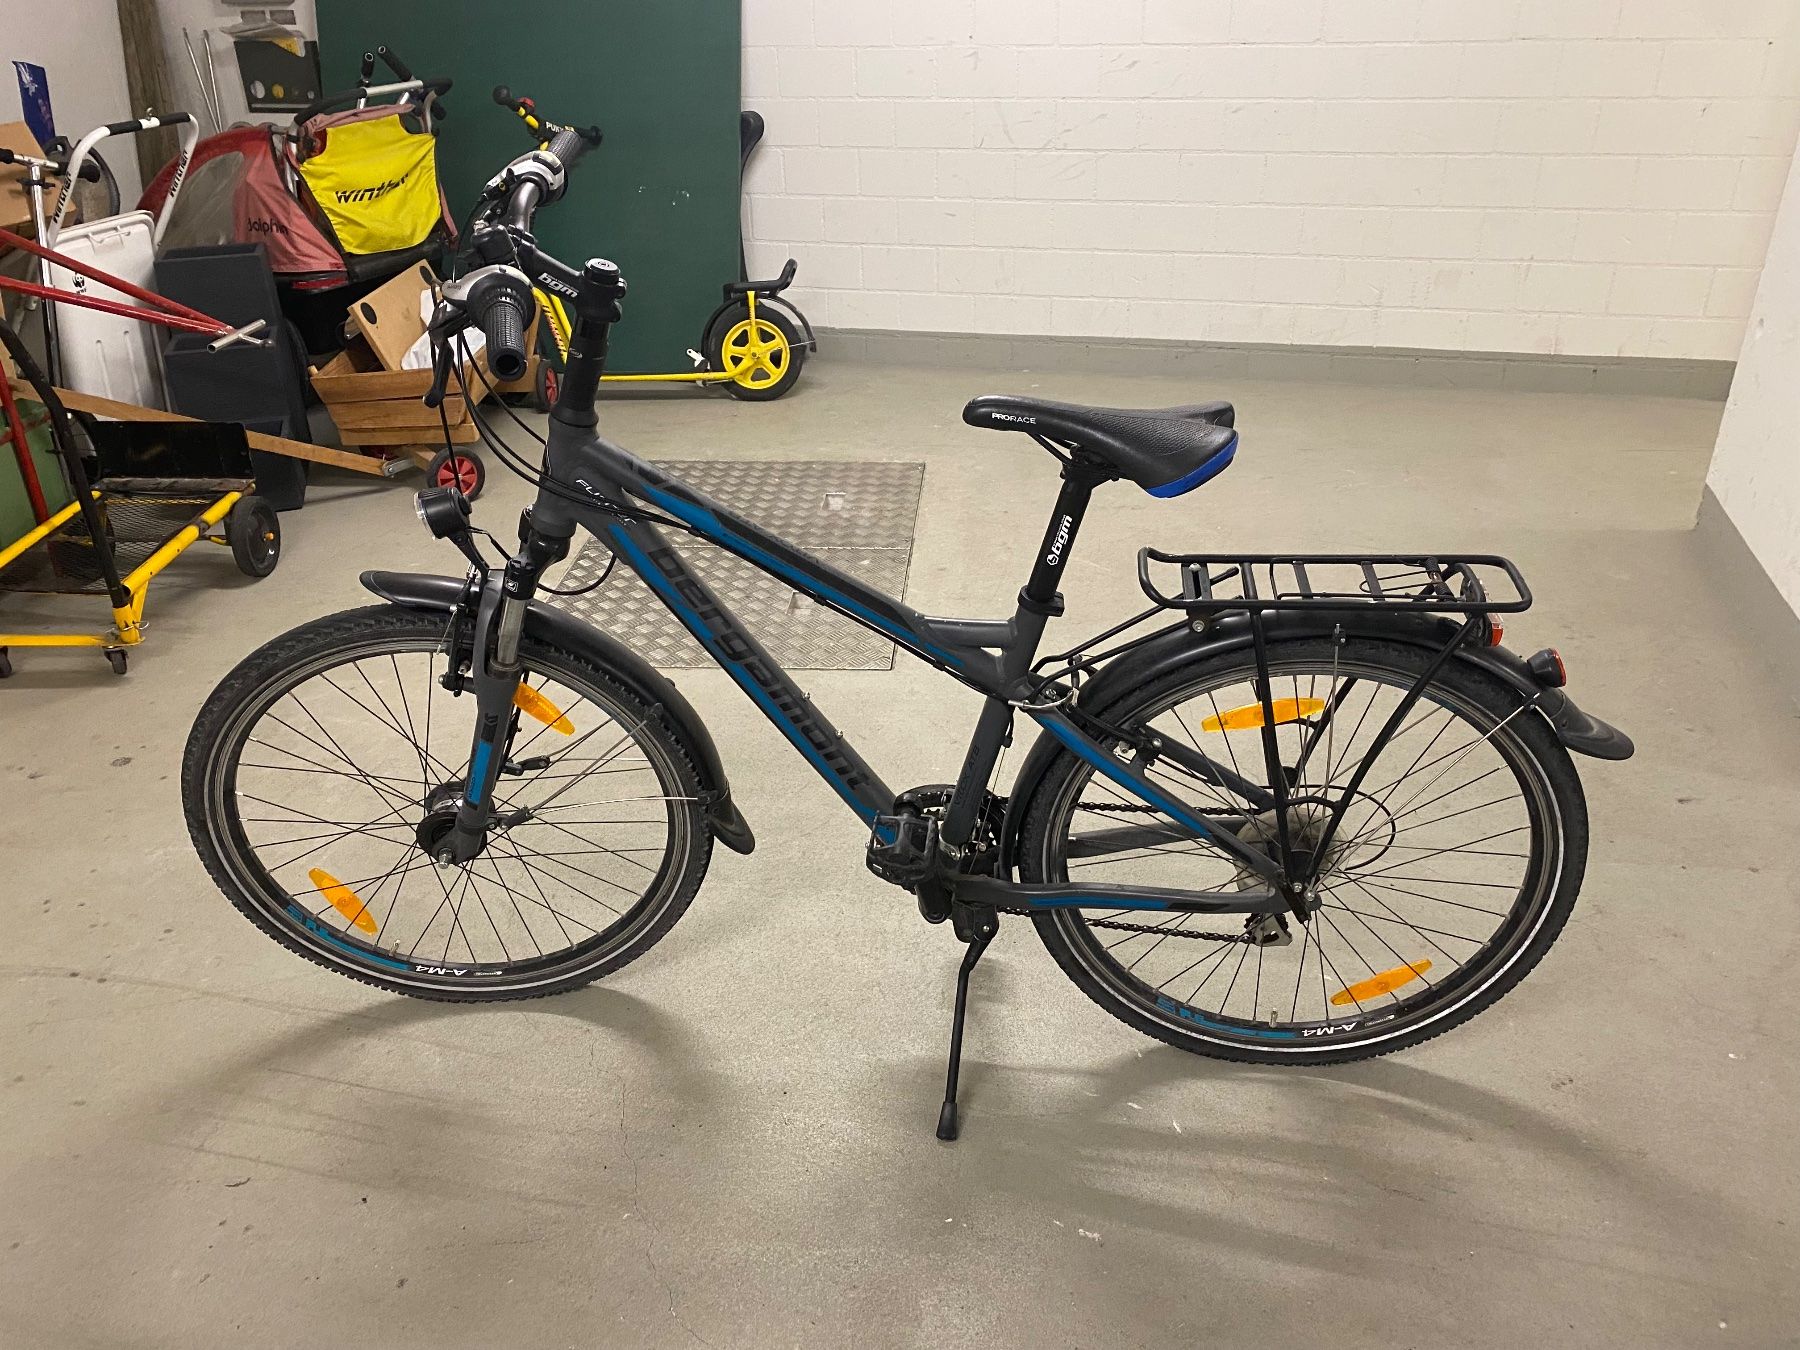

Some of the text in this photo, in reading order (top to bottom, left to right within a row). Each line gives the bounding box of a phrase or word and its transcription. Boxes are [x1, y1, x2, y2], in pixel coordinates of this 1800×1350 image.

[537, 272, 580, 299] bgm
[991, 412, 1037, 425] PRORACE
[1051, 515, 1073, 556] bgm
[649, 547, 871, 790] bergamont
[415, 964, 468, 977] A-M4
[1302, 1021, 1359, 1038] A-M4
